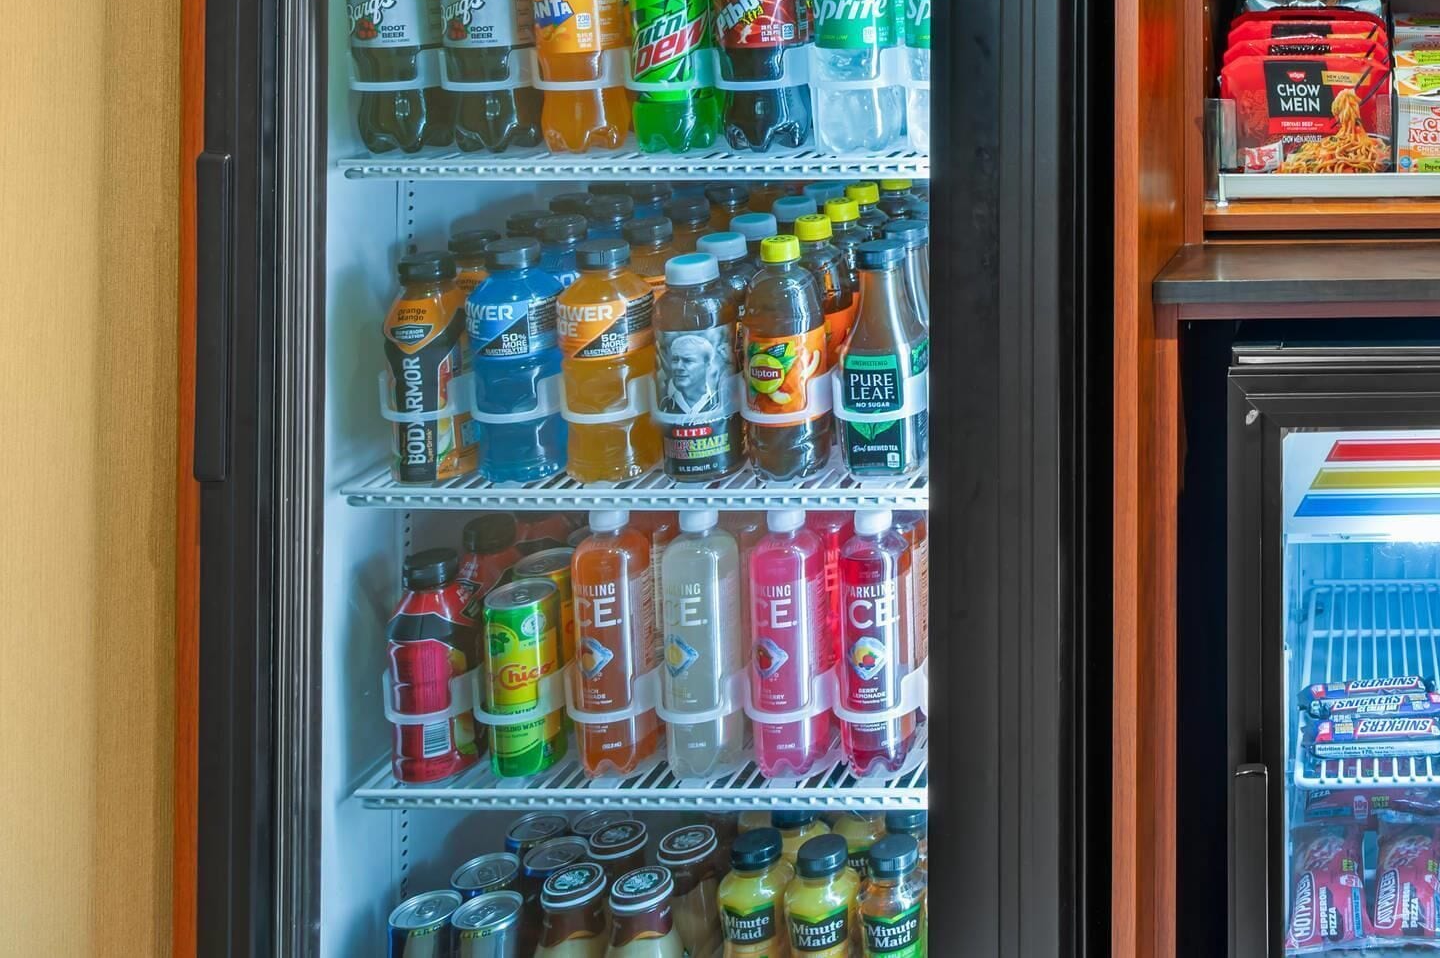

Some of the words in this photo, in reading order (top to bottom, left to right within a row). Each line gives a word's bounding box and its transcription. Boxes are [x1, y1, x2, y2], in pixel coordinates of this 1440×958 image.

[382, 31, 405, 39] BEER
[1277, 84, 1320, 97] CHOW
[1280, 98, 1320, 112] MEIN
[501, 333, 527, 342] 50%
[601, 333, 627, 342] 50%
[503, 341, 528, 349] MORE
[602, 341, 627, 350] MORE
[750, 368, 778, 380] Lipton
[850, 373, 894, 387] PURE
[676, 428, 707, 437] LITE
[1351, 676, 1416, 689] SNICKERS
[1336, 695, 1401, 709] SNICKERS
[1360, 720, 1430, 732] SNICKERS
[1319, 886, 1329, 937] PEPPERONI
[1402, 882, 1411, 929] PEPPERONI
[1410, 897, 1419, 929] PIZZA
[726, 915, 770, 928] Minute
[791, 918, 844, 937] Minute
[1329, 906, 1338, 936] PIZZA
[730, 927, 762, 941] Maid
[799, 931, 839, 947] Maid
